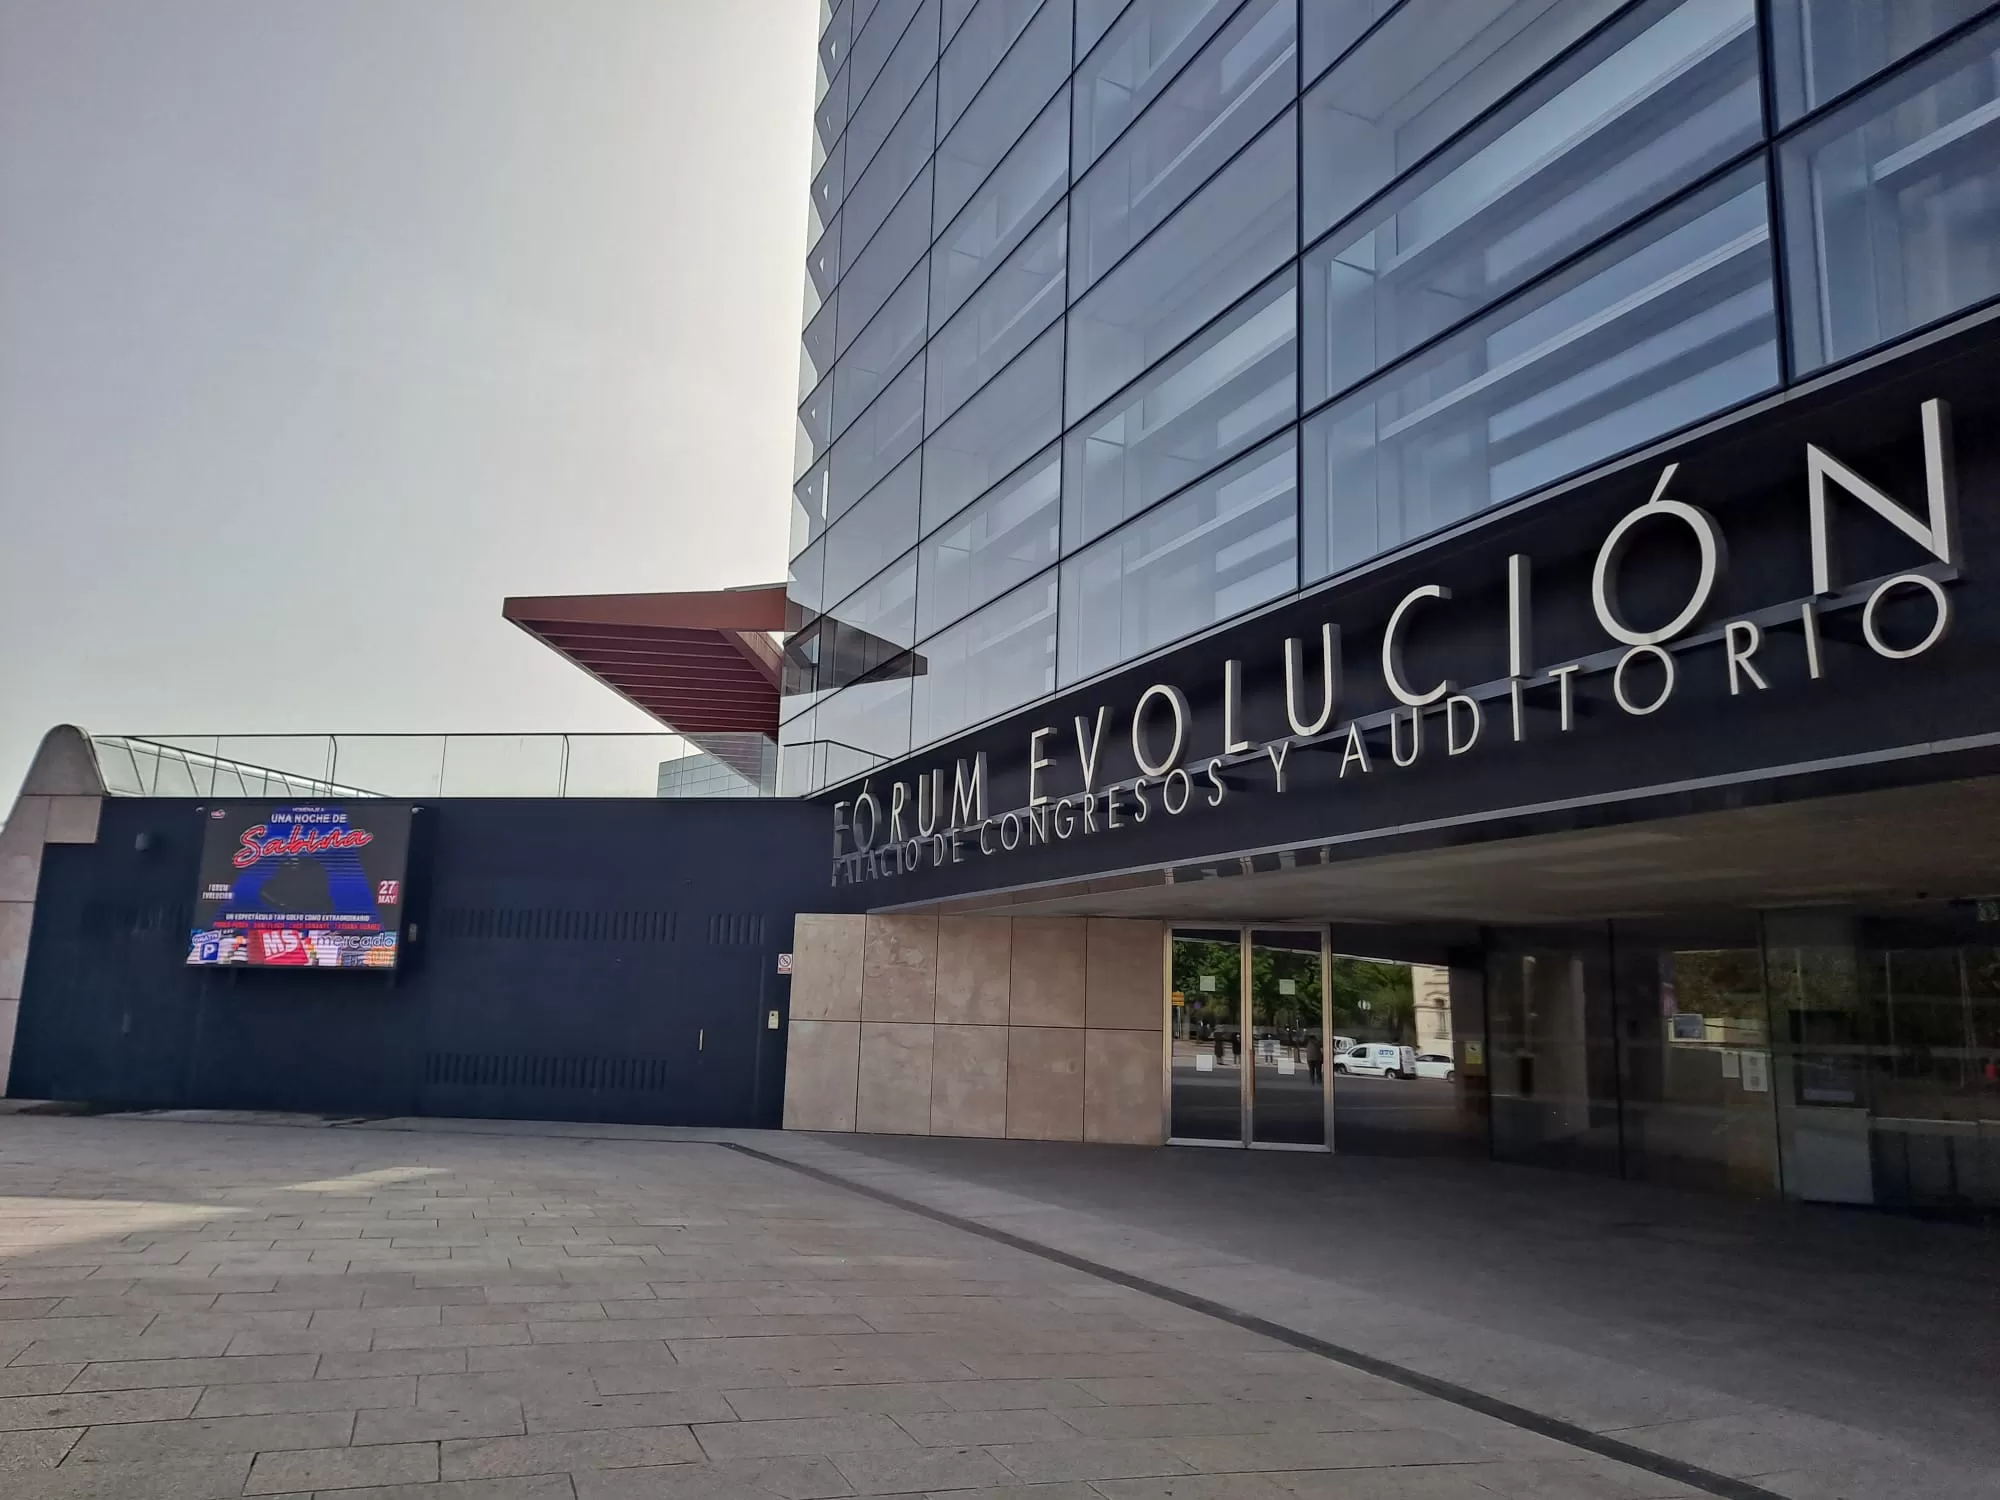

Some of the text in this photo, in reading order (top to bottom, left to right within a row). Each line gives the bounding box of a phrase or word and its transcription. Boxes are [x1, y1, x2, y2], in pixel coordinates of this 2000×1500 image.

[833, 397, 1952, 858] FÓRUM EVOLUCIÓN
[831, 573, 1951, 888] PALACIO DE CONGRESOS Y AUDITORIO
[271, 814, 348, 824] UNA NOCHE DE
[232, 824, 374, 868] Sabina
[379, 881, 396, 894] 27
[316, 932, 397, 948] mercado
[203, 943, 215, 959] P
